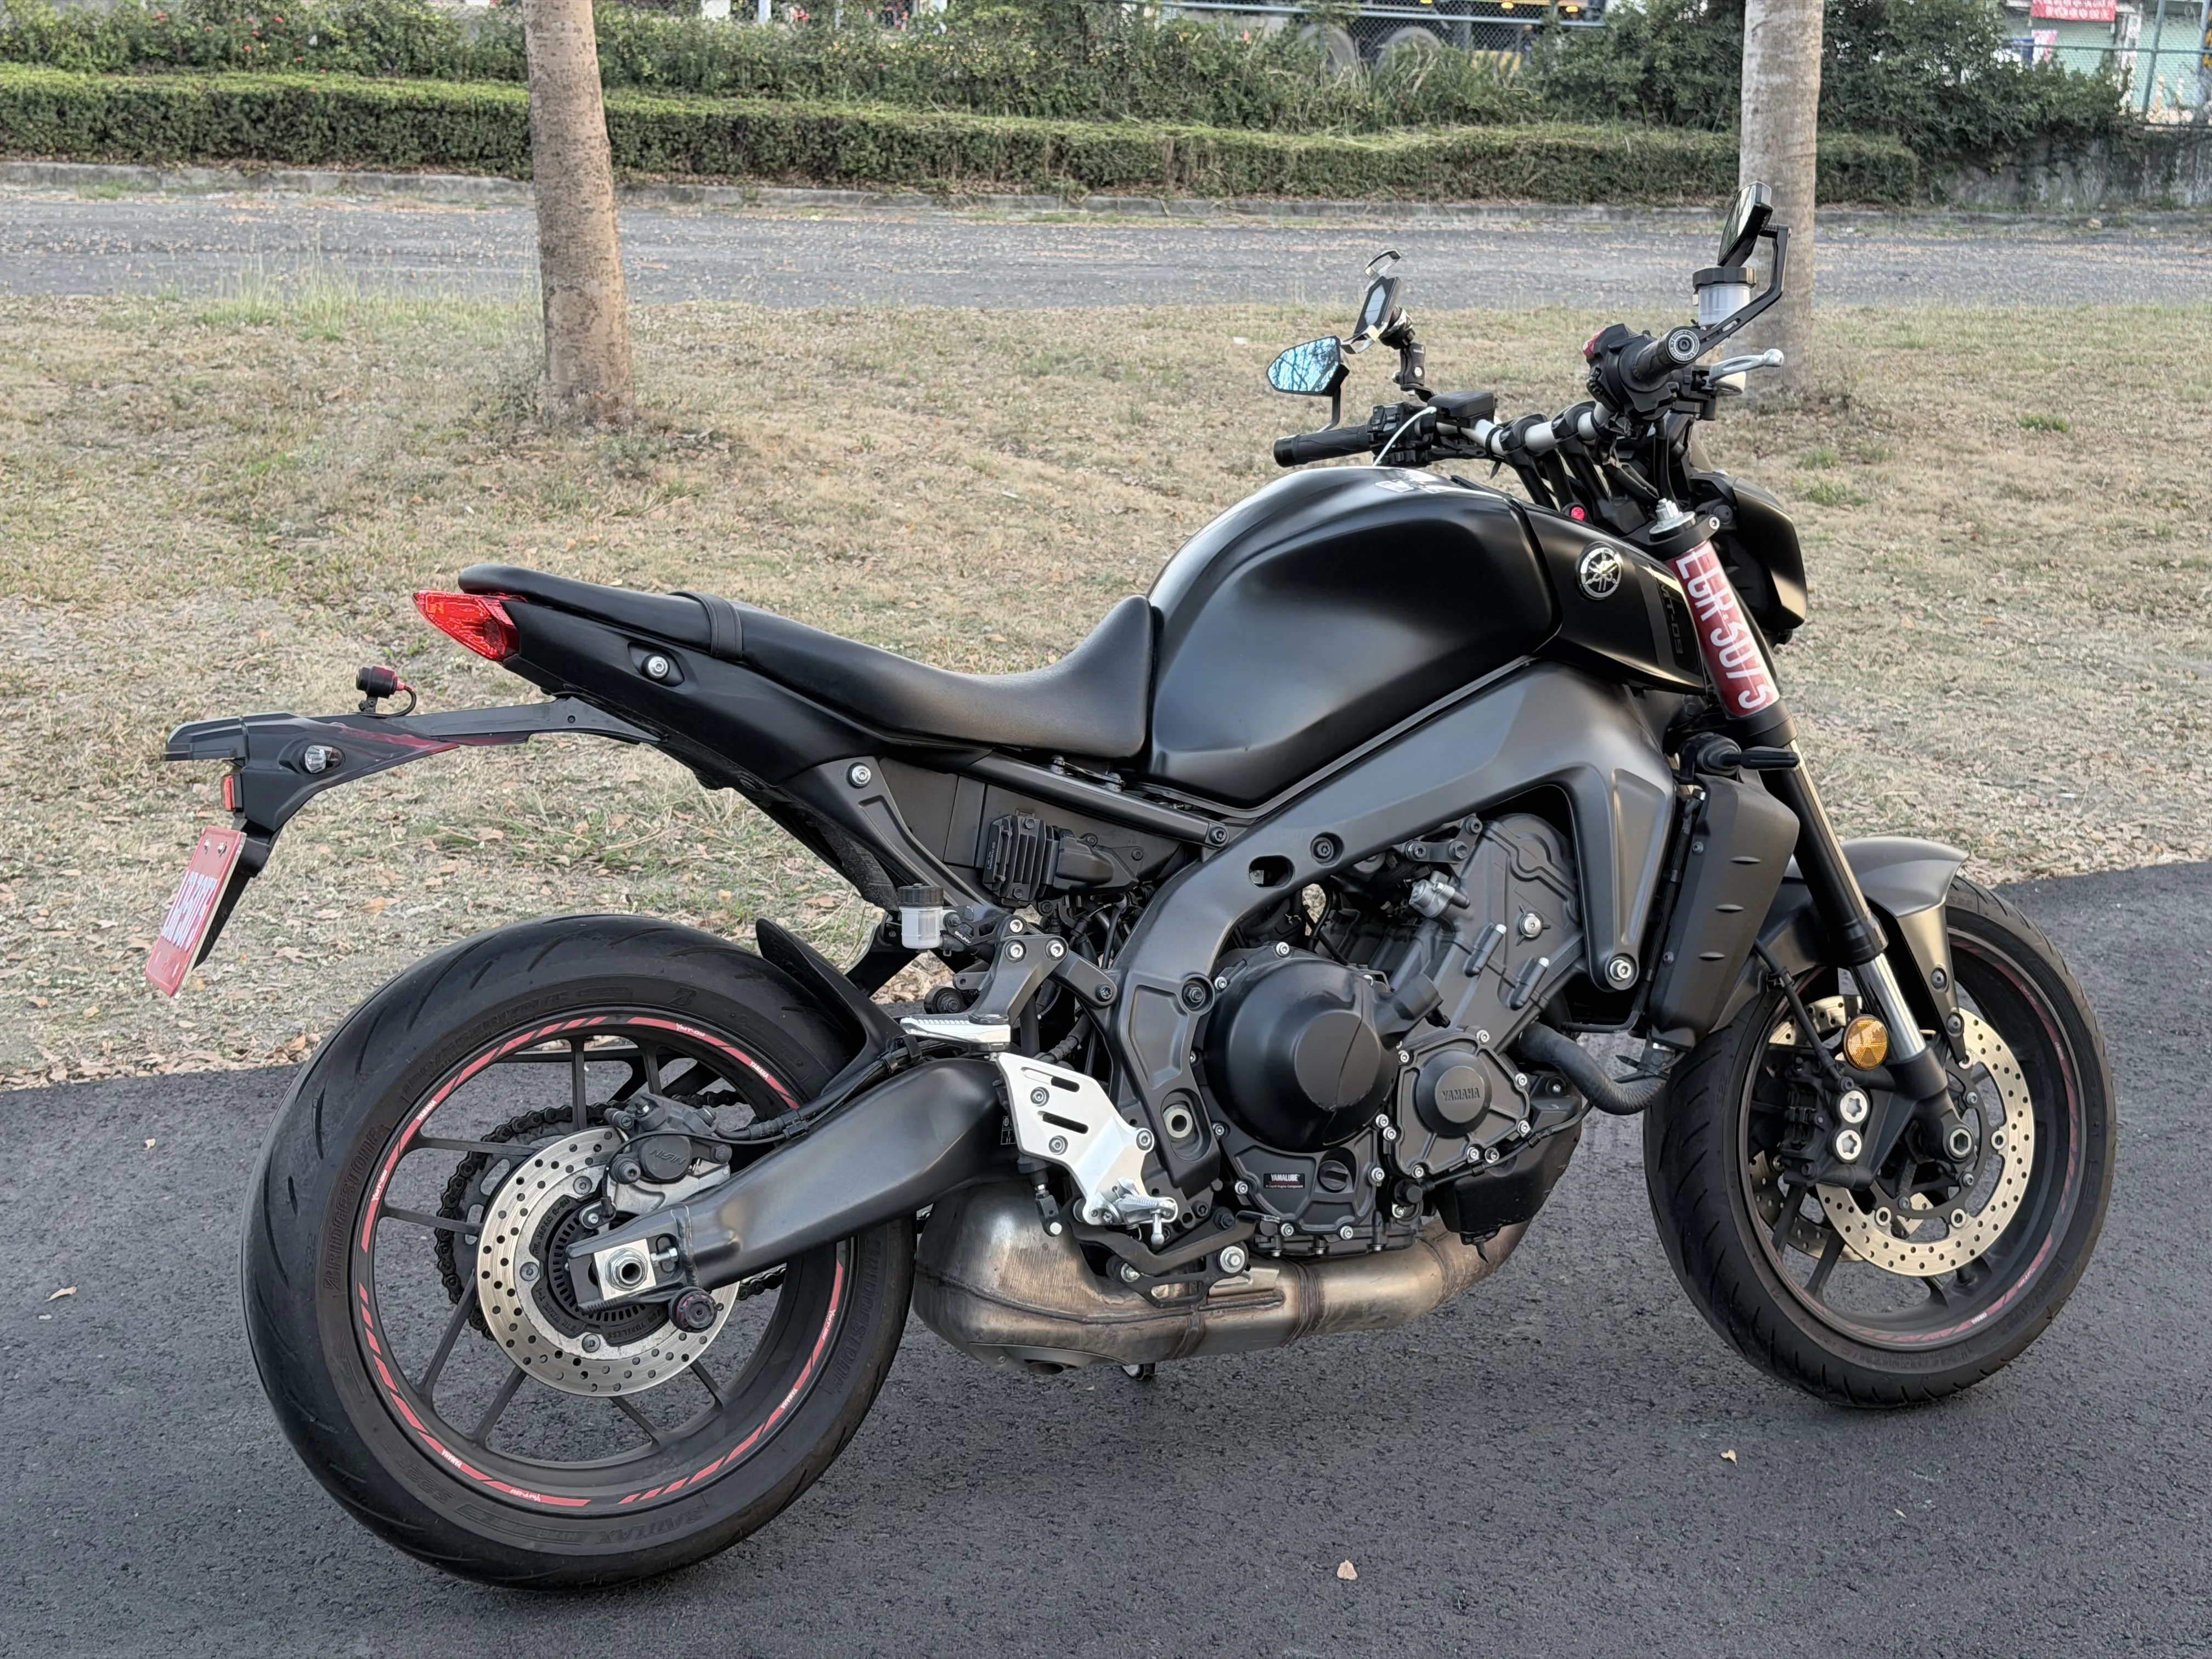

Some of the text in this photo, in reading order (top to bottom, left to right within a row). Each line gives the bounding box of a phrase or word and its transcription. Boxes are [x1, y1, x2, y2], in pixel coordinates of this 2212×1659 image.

[1660, 584, 1683, 654] MT-09
[750, 1060, 769, 1080] YAMAHA
[1442, 1087, 1480, 1102] YAMAHA
[416, 1100, 436, 1121] YAMAHA
[323, 1124, 382, 1291] BRIDGESTONE
[779, 1388, 798, 1408] YAMAHA
[440, 1449, 462, 1469] YAMAHA
